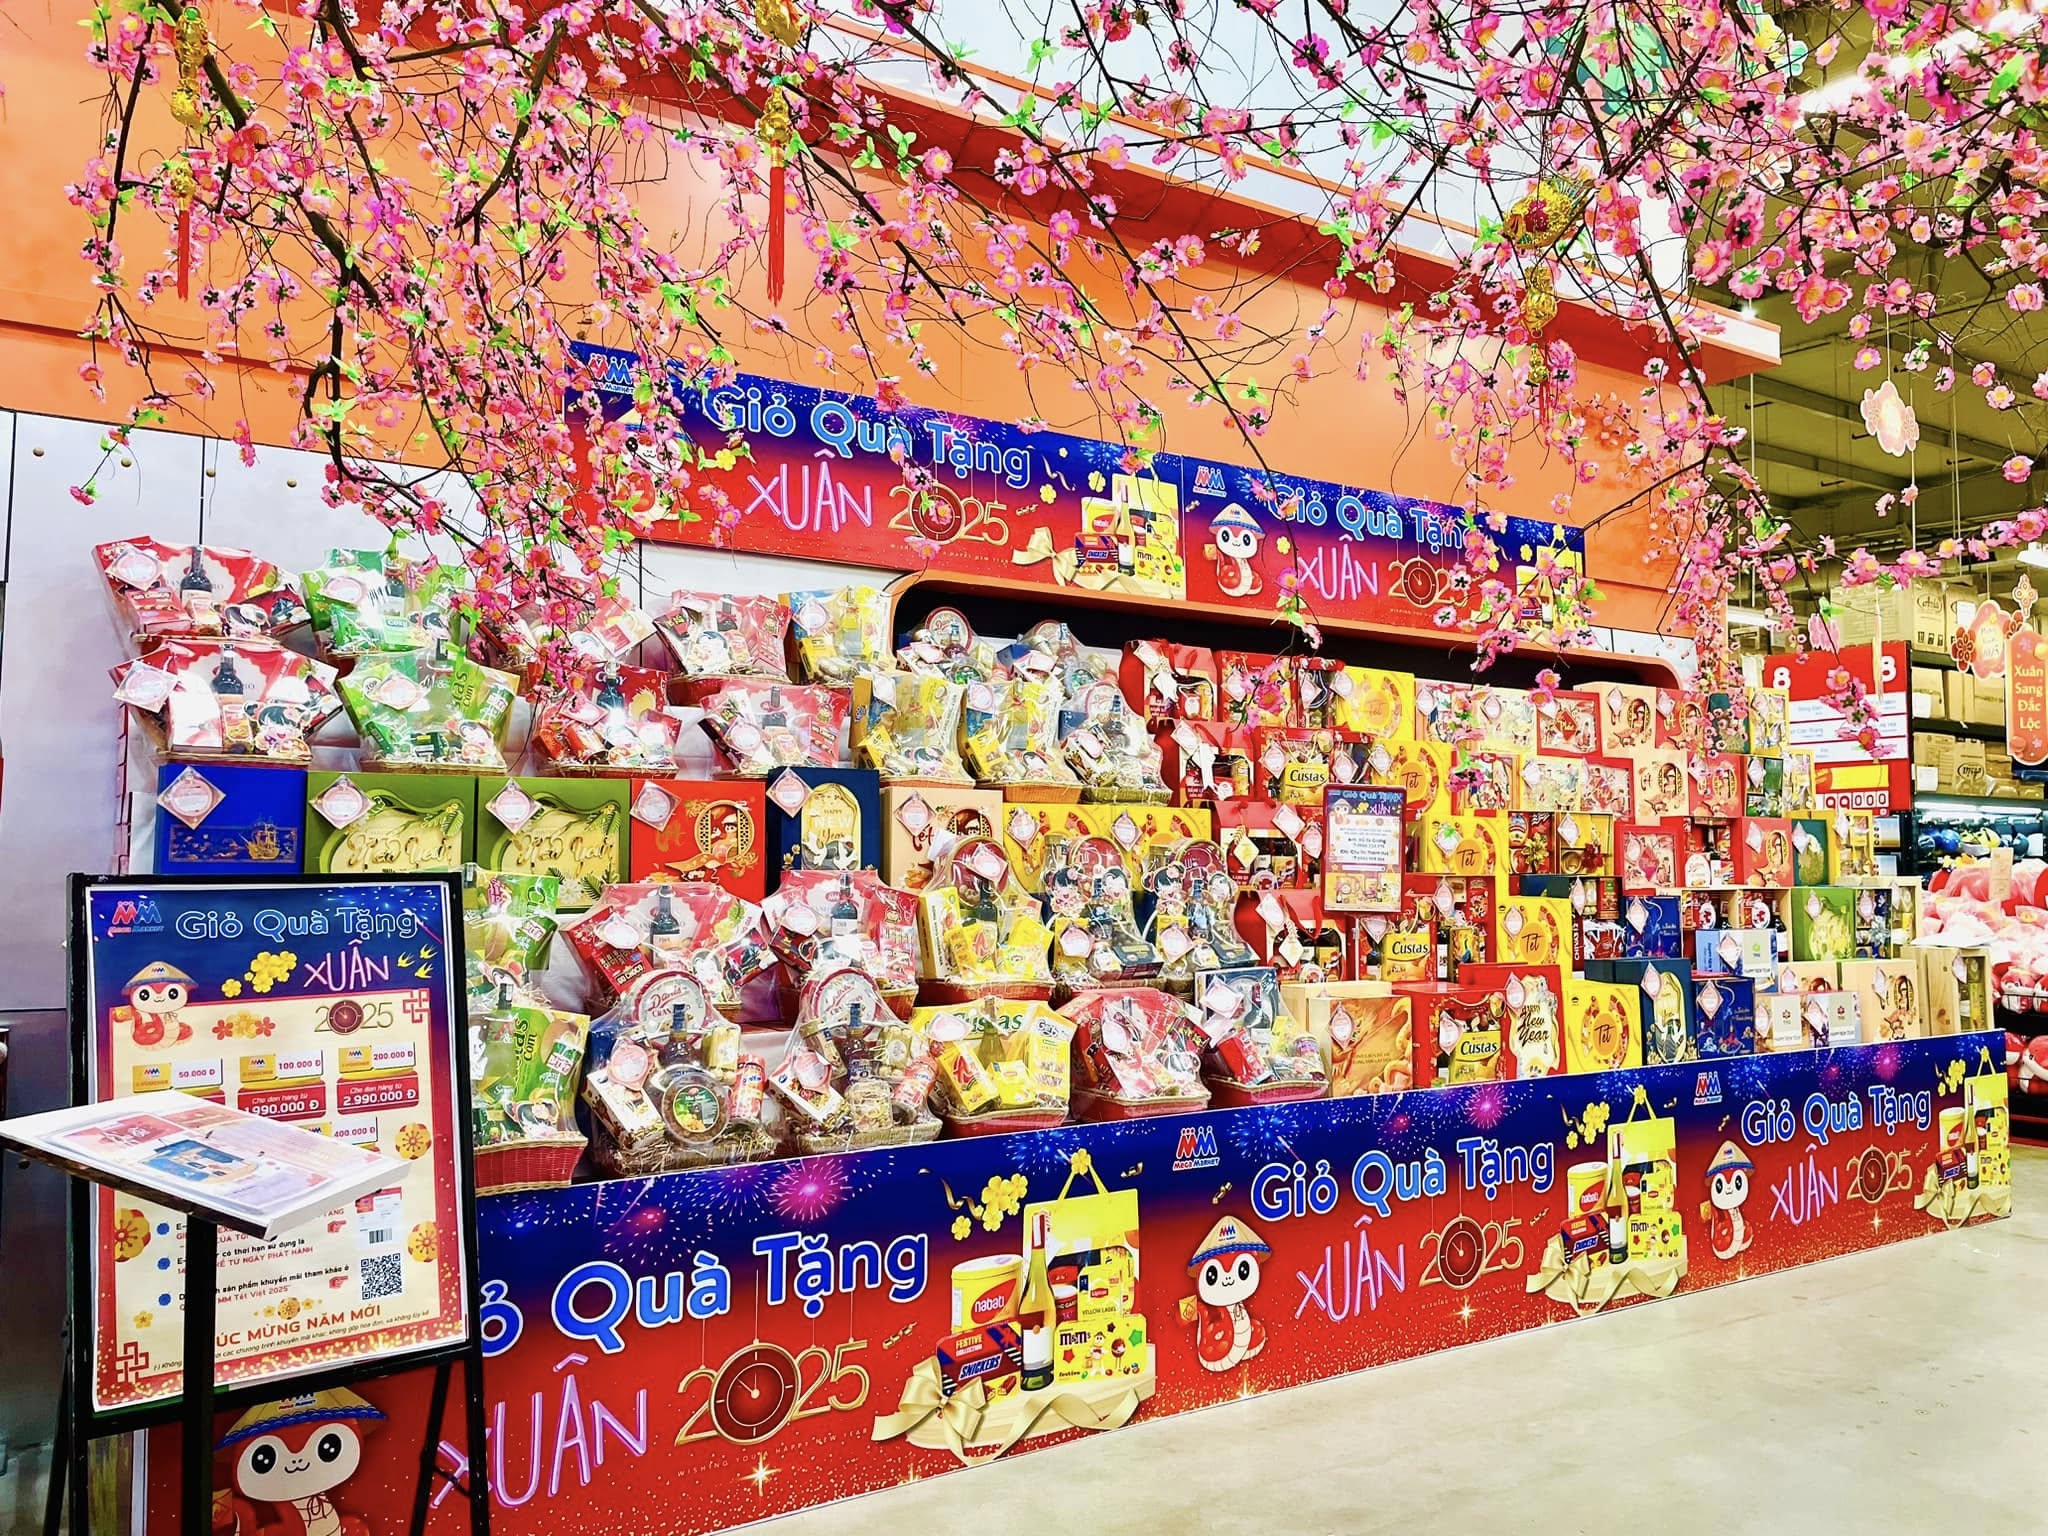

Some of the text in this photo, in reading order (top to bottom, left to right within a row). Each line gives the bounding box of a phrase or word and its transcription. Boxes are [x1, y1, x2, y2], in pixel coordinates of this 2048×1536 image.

[701, 386, 1031, 490] Giỏ Quà Tặng
[745, 449, 873, 533] XUÂN
[888, 480, 1010, 546] 2025
[1268, 484, 1468, 554] Giỏ Quà Tặn
[1297, 534, 1379, 601] XUÂN
[595, 671, 627, 686] CY
[1773, 667, 1791, 690] 8
[2014, 664, 2043, 677] Xuân
[2015, 684, 2043, 698] Sang
[2018, 697, 2041, 712] Đắc
[2020, 716, 2041, 731] Lộc
[1290, 769, 1326, 783] Custas
[175, 906, 418, 943] Giỏ Quà Tặng
[303, 938, 390, 991] XUÂN
[1392, 940, 1429, 955] Custas
[314, 1001, 394, 1036] 2025
[278, 1060, 312, 1071] 100.000
[373, 1051, 405, 1061] 200.000
[1460, 1040, 1497, 1056] Custas
[178, 1069, 206, 1079] 50.000
[343, 1091, 403, 1107] 2.990.000
[1741, 1084, 1932, 1147] Giỏ Quà Tặng
[334, 1128, 367, 1138] 400.000
[1251, 1136, 1555, 1221] Giỏ Quà Tặng
[1770, 1143, 1839, 1226] XUÂN
[1846, 1143, 1913, 1204] 2025
[1295, 1215, 1406, 1321] XUÂN
[1418, 1215, 1524, 1291] 2025
[551, 1253, 732, 1354] Quà
[753, 1231, 929, 1318] Tặng
[216, 1303, 382, 1348] ÚC MỪNG NĂM MỚI
[959, 1355, 1001, 1380] SNICKERS
[674, 1338, 871, 1446] 2025
